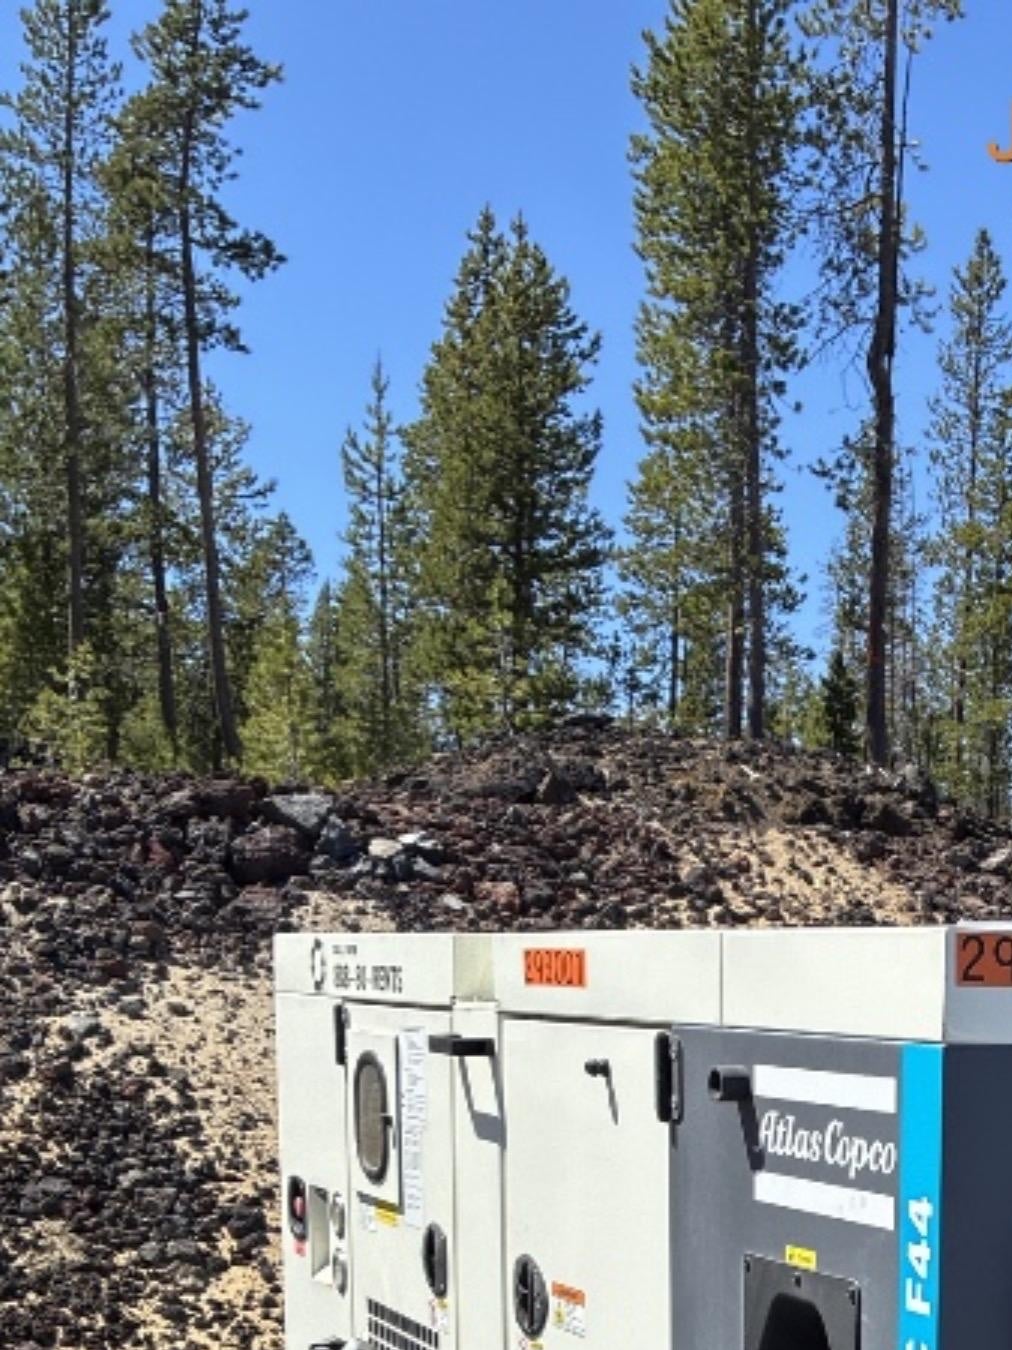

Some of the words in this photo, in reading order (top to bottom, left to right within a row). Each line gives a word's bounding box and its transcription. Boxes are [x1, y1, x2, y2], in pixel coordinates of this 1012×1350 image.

[758, 1111, 822, 1162] Atlas
[824, 1118, 896, 1180] Copco
[904, 1197, 934, 1316] F44
